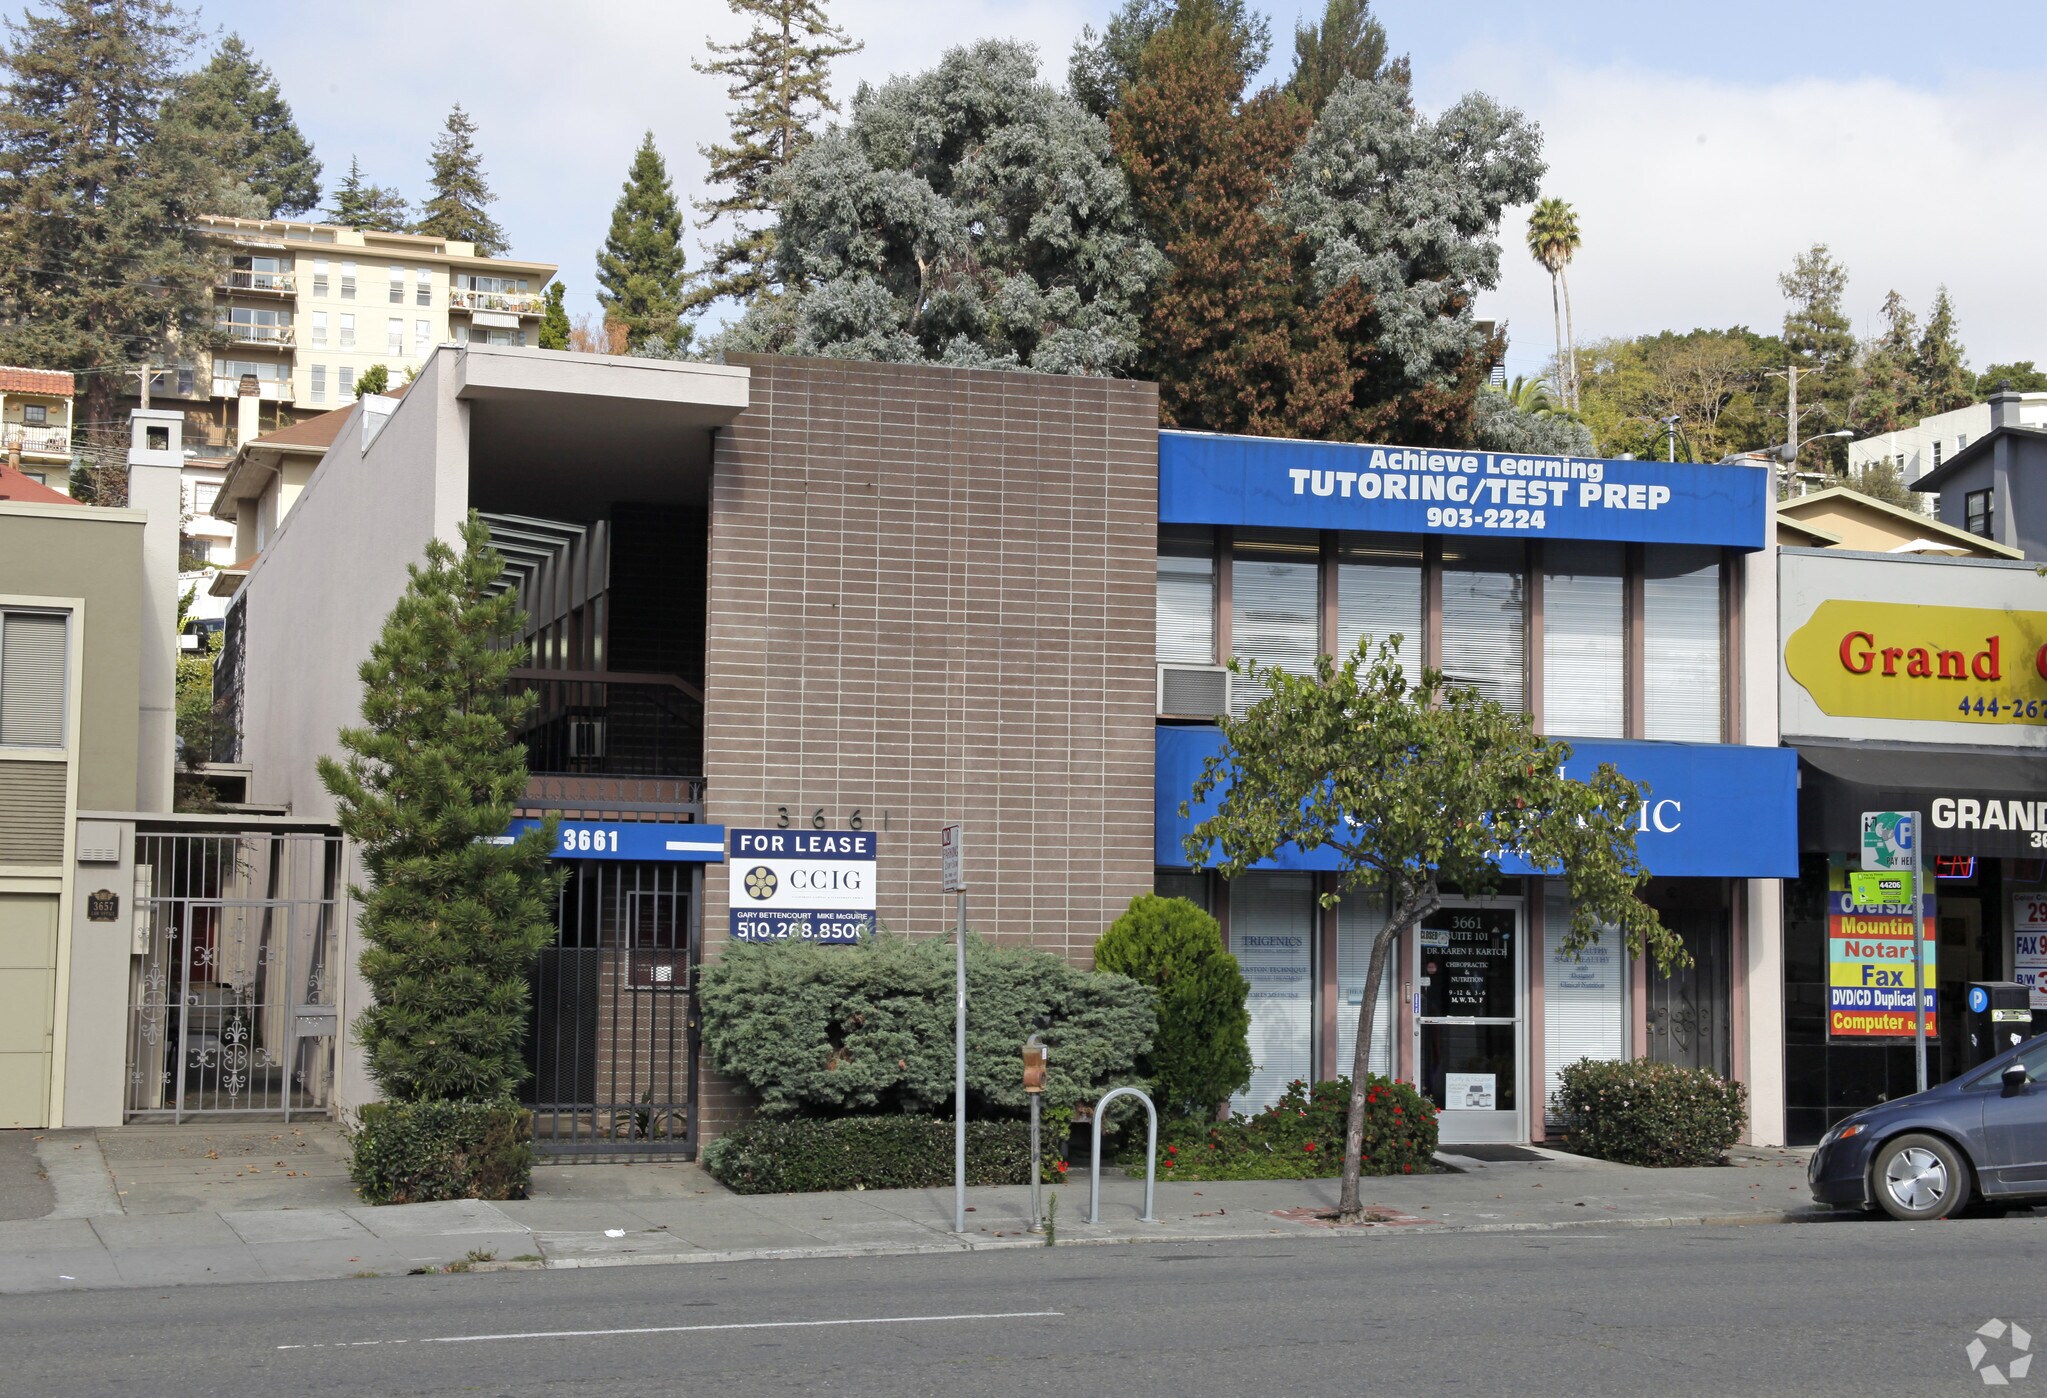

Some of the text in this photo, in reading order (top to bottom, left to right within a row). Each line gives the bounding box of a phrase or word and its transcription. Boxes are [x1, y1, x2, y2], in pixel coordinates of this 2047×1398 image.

[1369, 450, 1603, 483] Achieve Learning
[1288, 469, 1671, 510] TUTORING/TEST PREP
[1427, 508, 1546, 530] 903-2224
[1840, 631, 2001, 681] Grand
[777, 806, 888, 832] 3661
[563, 829, 617, 852] 3661
[741, 835, 867, 854] FOR LEASE
[1886, 856, 1899, 866] PAY
[790, 869, 862, 891] CCIG
[1879, 881, 1901, 889] 44206
[93, 901, 114, 911] 3657
[1840, 892, 1924, 915] Oversiz
[737, 911, 868, 921] GARY BETTENCOURT MIKE McGUIRE
[1452, 916, 1483, 930] 3661
[1446, 931, 1489, 941] SUITE 101
[1841, 917, 1925, 940] Mountin
[1242, 935, 1303, 947] TRIGENICS
[1426, 947, 1439, 955] DR.
[1441, 947, 1467, 955] KAREN
[2016, 936, 2037, 955] FAX
[1862, 964, 1905, 987] Fax
[1832, 989, 1934, 1011] DVD/CD Duplicatn
[1973, 990, 1984, 1009] P
[1833, 1012, 1933, 1033] Computer Real
